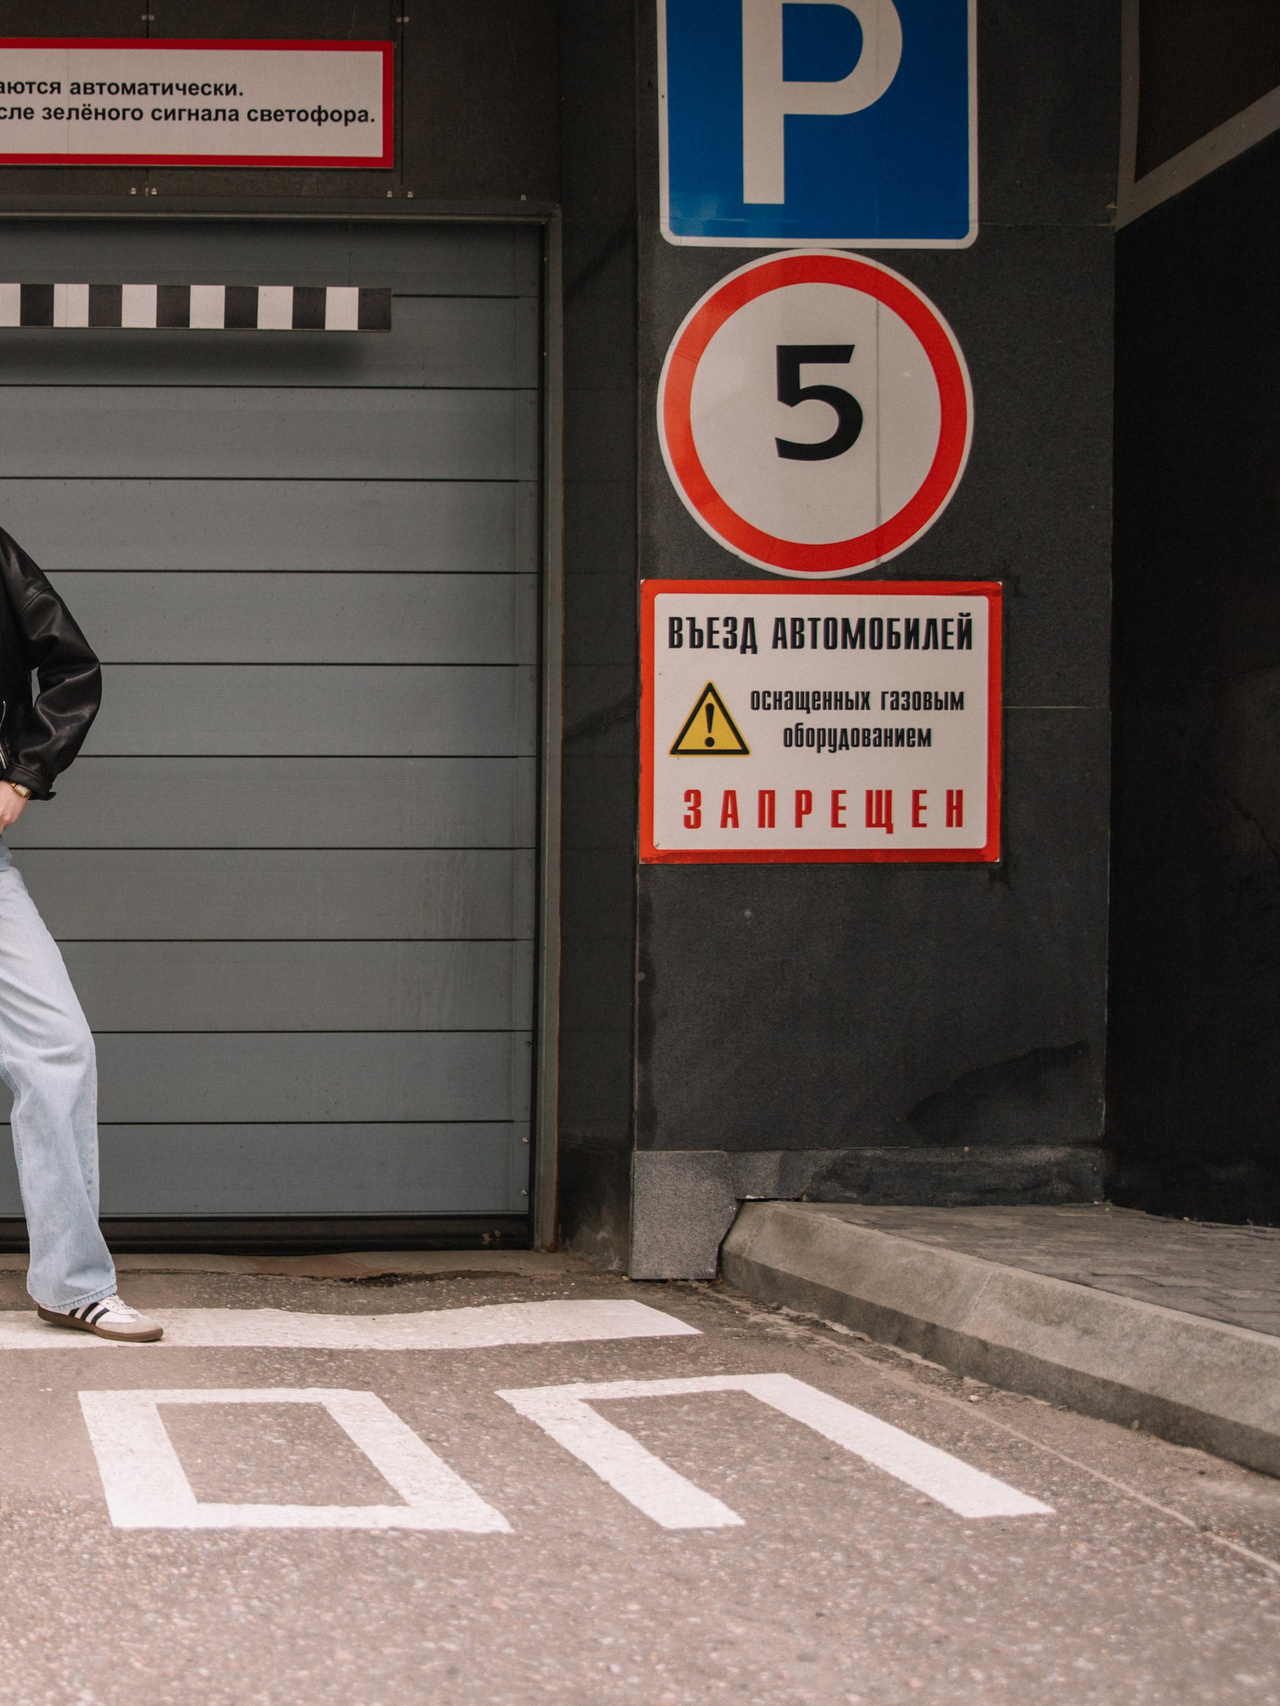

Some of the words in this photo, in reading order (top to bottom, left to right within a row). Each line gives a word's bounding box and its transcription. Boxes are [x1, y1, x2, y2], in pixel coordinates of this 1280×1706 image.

[70, 82, 243, 96] автоматически.
[742, 0, 902, 204] P
[42, 104, 143, 121] зелёного
[151, 108, 239, 121] сигнала
[247, 105, 374, 126] светофора.
[775, 344, 863, 461] 5
[669, 617, 757, 654] ВЪЕЗД
[772, 612, 972, 650] АВТОМОБИЛЕЙ
[751, 691, 870, 714] оснащенных
[881, 691, 964, 711] газовым
[784, 723, 931, 753] оборудованием
[684, 789, 963, 834] ЗАПРЕЩЕН
